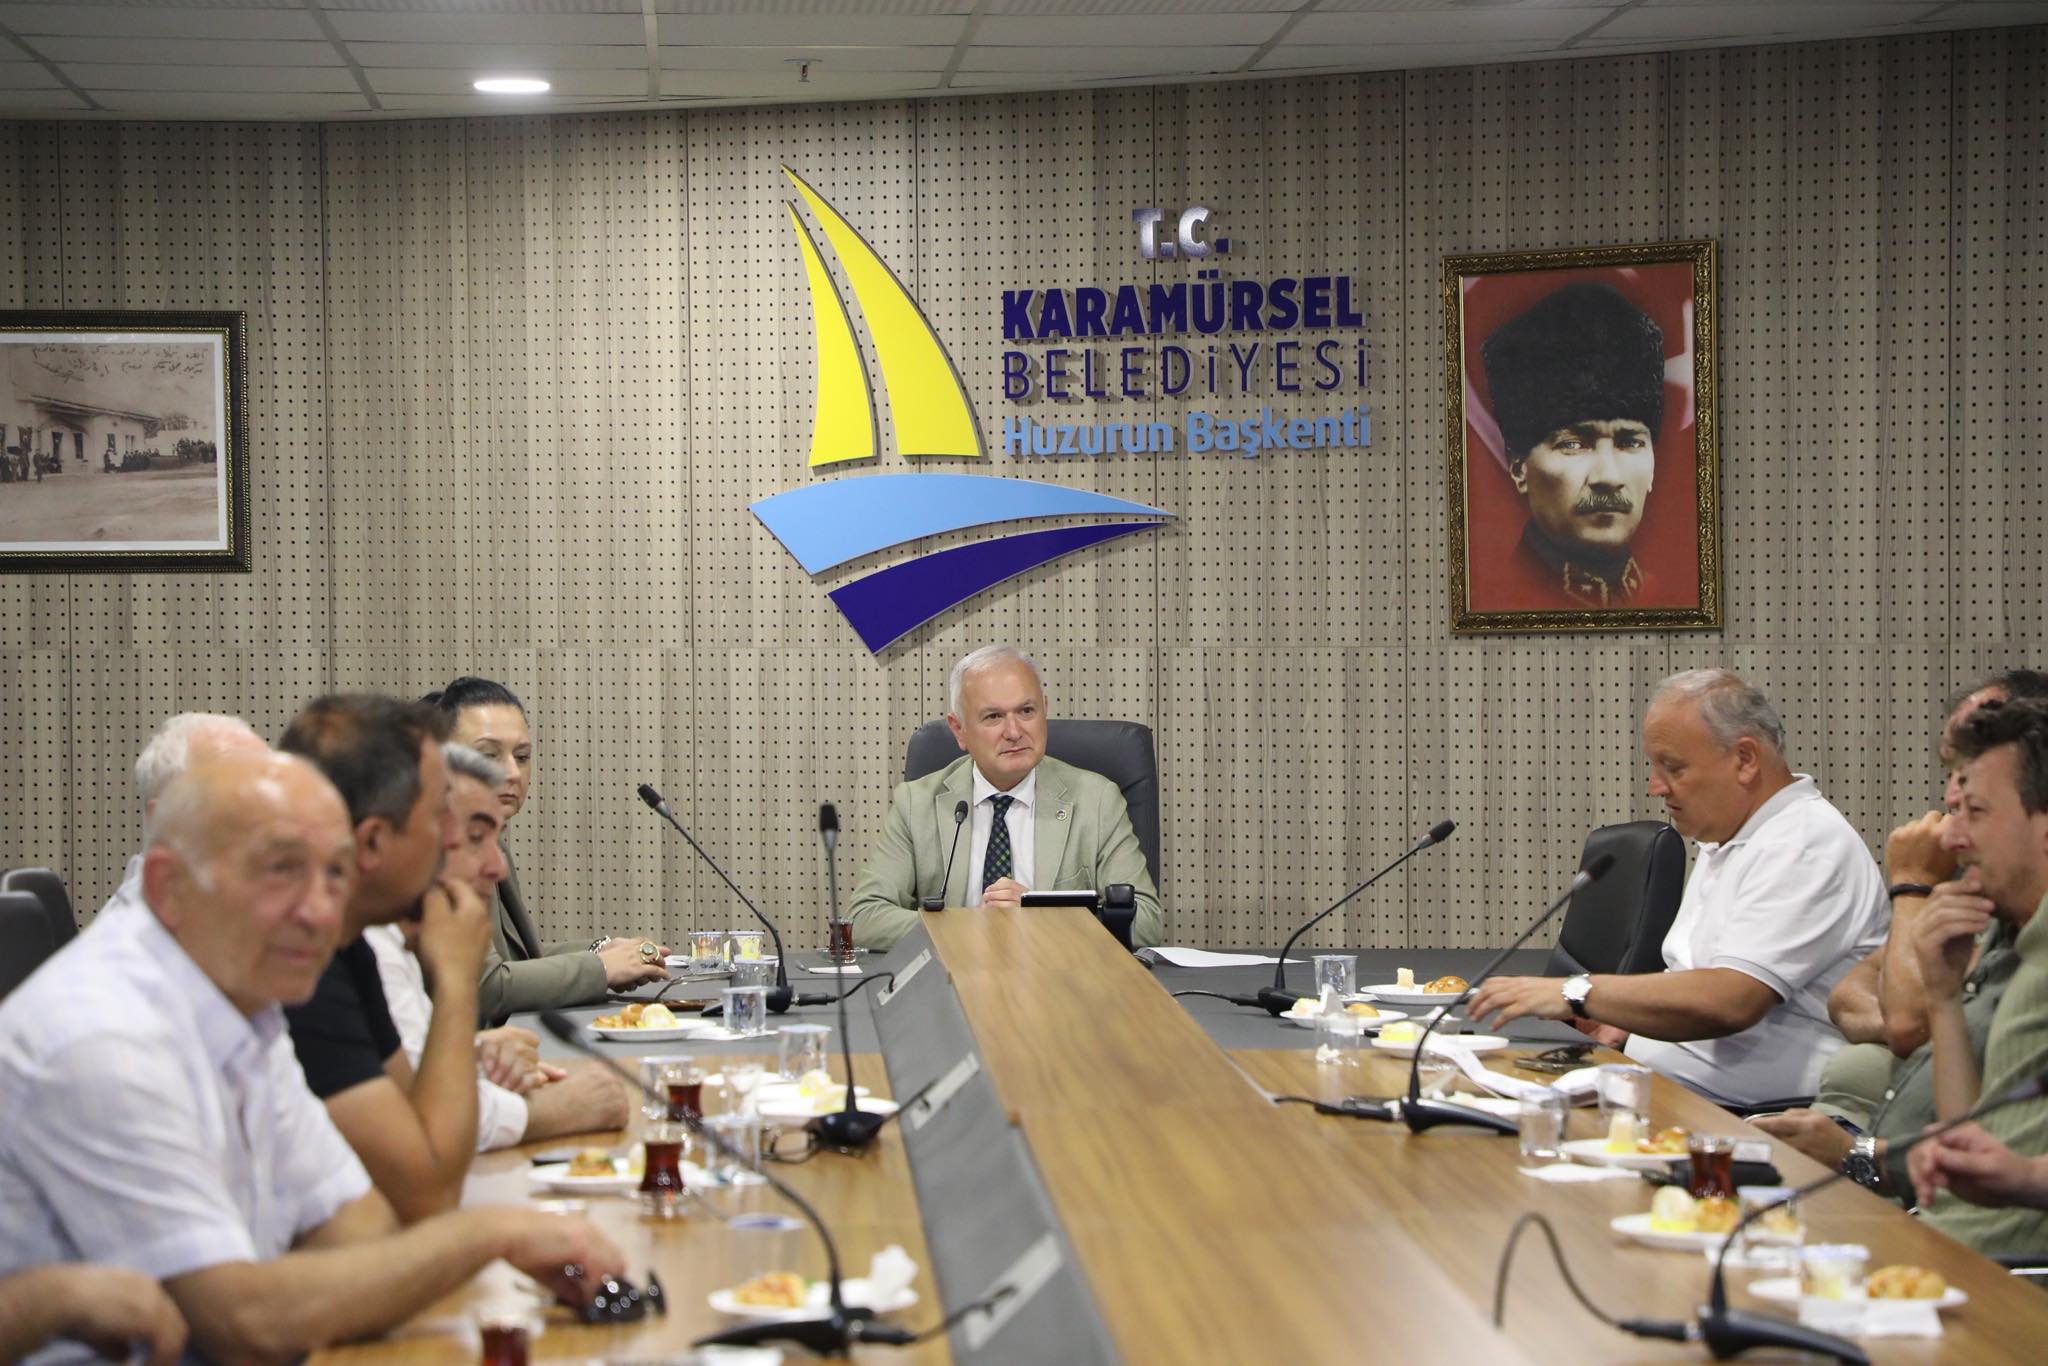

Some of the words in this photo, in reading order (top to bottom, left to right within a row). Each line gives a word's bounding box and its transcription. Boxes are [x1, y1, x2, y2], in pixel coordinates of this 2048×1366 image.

[1132, 207, 1230, 259] T.C.
[1002, 269, 1363, 339] KARAMÜRSEL
[1003, 416, 1174, 457] Huzurun
[1187, 405, 1371, 459] Başkenti
